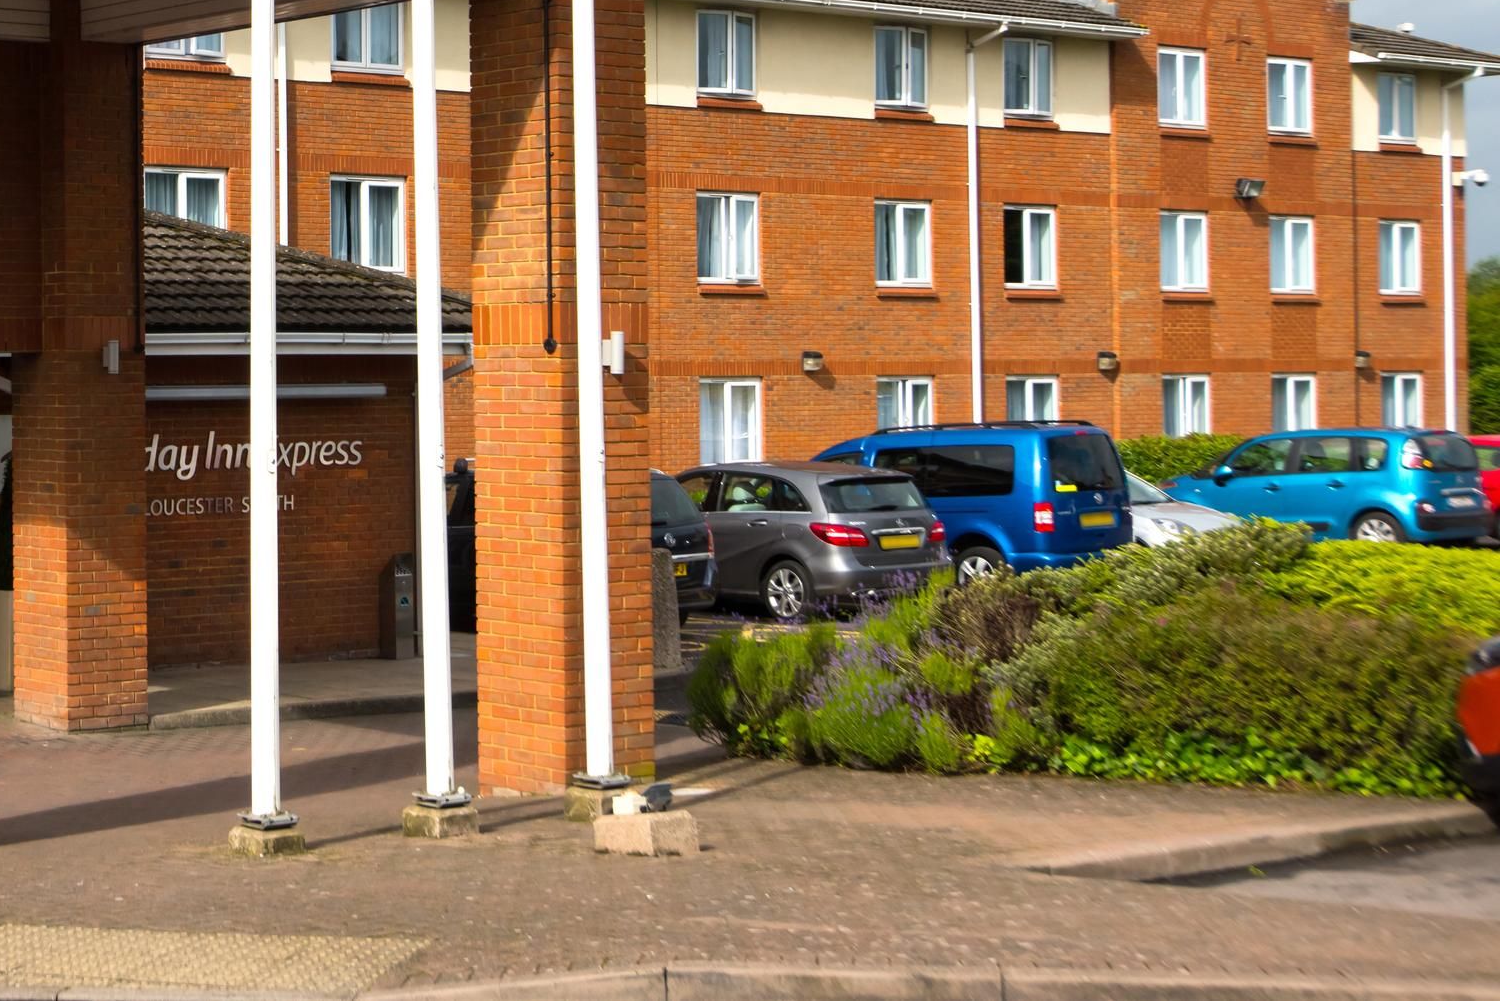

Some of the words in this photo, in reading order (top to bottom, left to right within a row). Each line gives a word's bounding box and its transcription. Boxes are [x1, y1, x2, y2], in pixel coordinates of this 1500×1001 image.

[205, 430, 251, 470] Inn
[277, 440, 363, 476] xpress
[241, 494, 295, 514] STH
